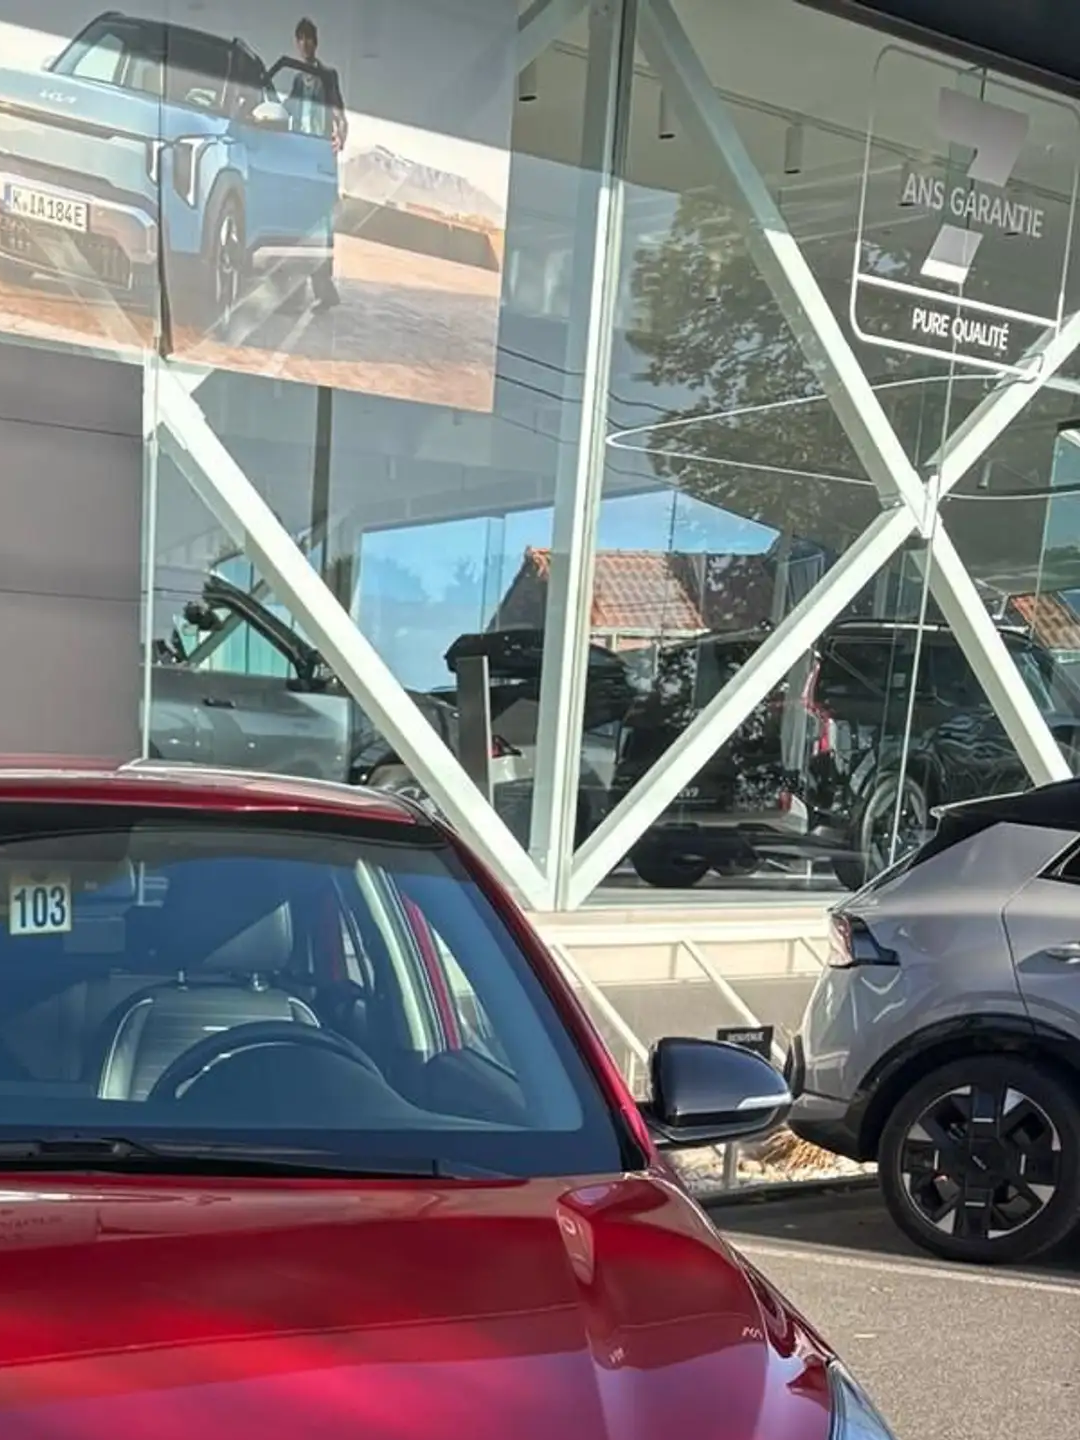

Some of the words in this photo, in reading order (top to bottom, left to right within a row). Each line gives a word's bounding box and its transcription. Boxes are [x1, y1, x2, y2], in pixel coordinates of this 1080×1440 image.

[901, 172, 945, 210] ANS
[950, 187, 1045, 238] GARANTIE
[912, 307, 950, 338] PURE
[952, 317, 1009, 350] QUALITÉ
[14, 886, 65, 928] 103
